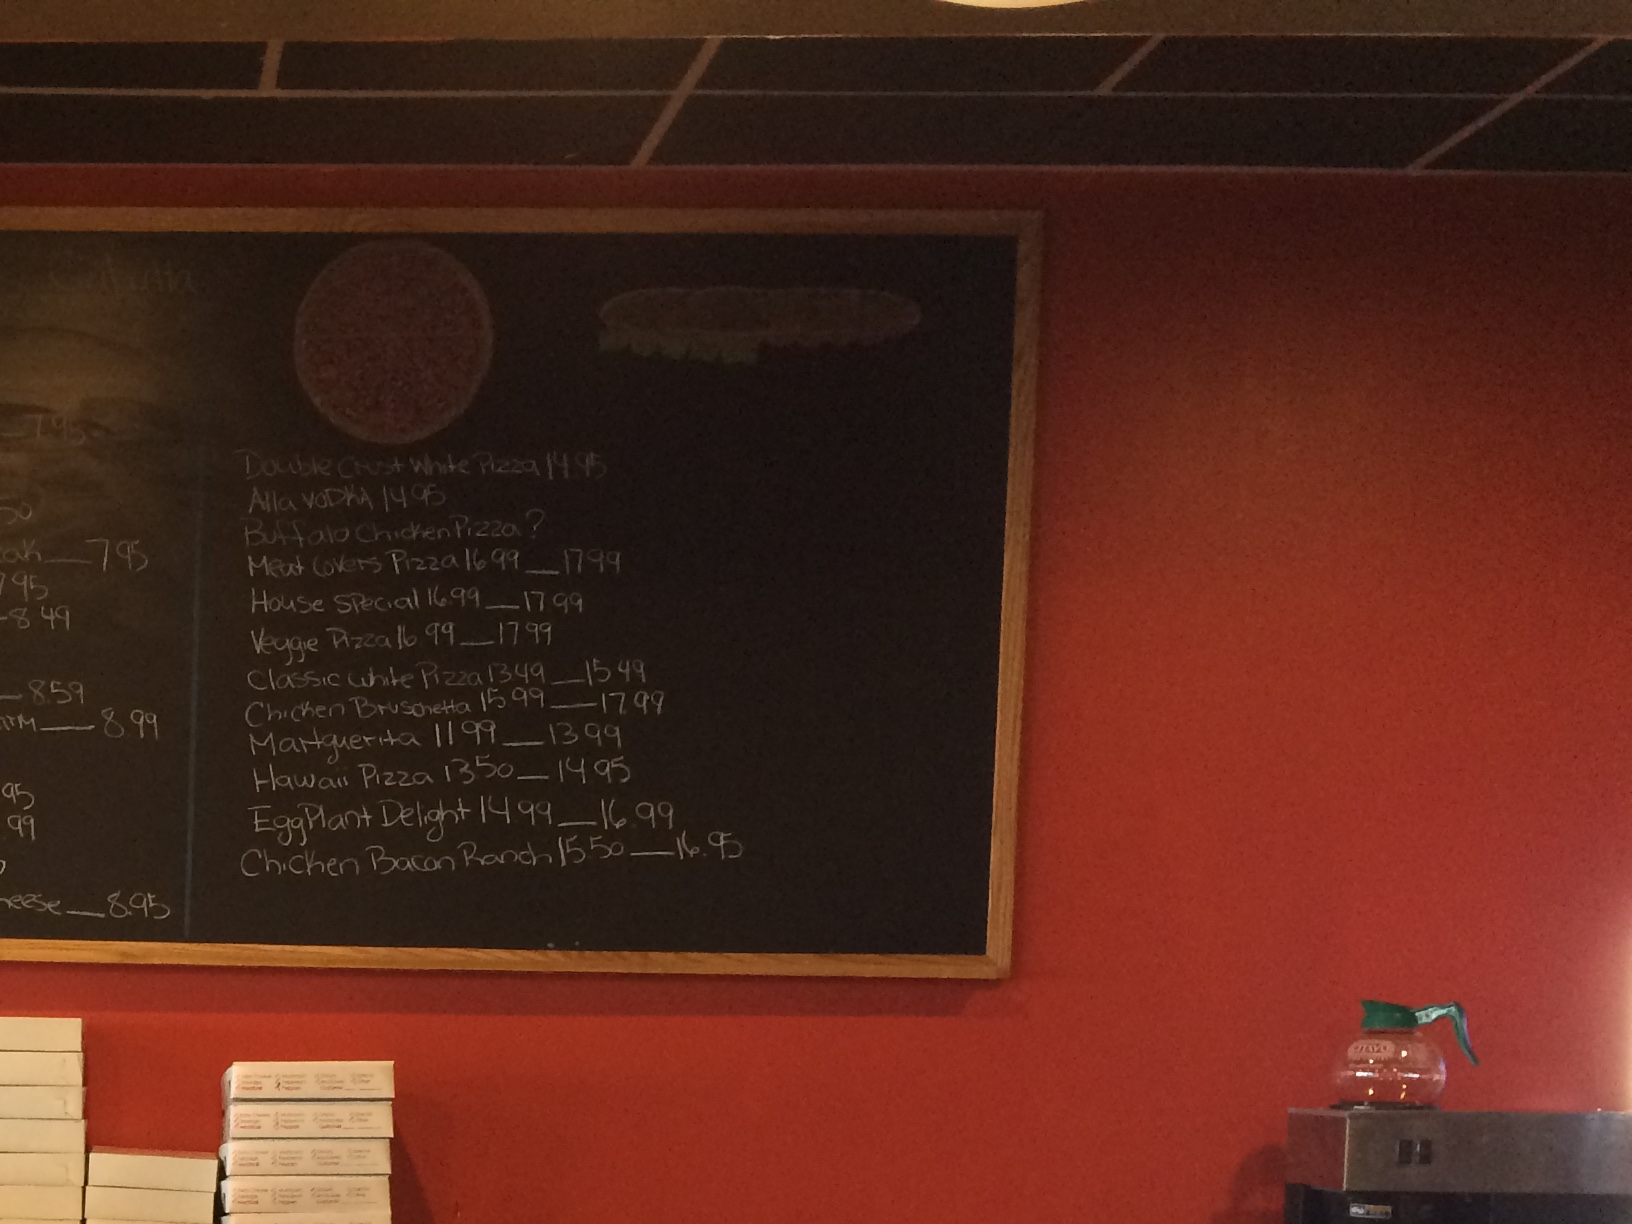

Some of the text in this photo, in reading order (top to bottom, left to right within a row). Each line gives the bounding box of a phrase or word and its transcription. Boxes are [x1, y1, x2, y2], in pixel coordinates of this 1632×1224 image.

[234, 449, 331, 480] Double
[473, 451, 540, 476] Pizza
[240, 516, 349, 548] Buffalo
[356, 519, 451, 542] Chicken
[450, 514, 522, 539] Pizza
[247, 555, 305, 579] Meat
[386, 549, 458, 576] Pizza
[251, 587, 325, 614] House
[252, 628, 319, 666] Veggie
[326, 627, 392, 648] Pizza
[247, 668, 342, 692] Classic
[417, 660, 482, 688] Pizza
[246, 699, 346, 728] Chicken
[254, 763, 349, 793] Hawaii
[360, 764, 434, 788] Pizza
[380, 798, 471, 843] Delight
[240, 848, 359, 877] Chicken
[366, 845, 455, 874] Bacon
[457, 841, 552, 869] Ranch
